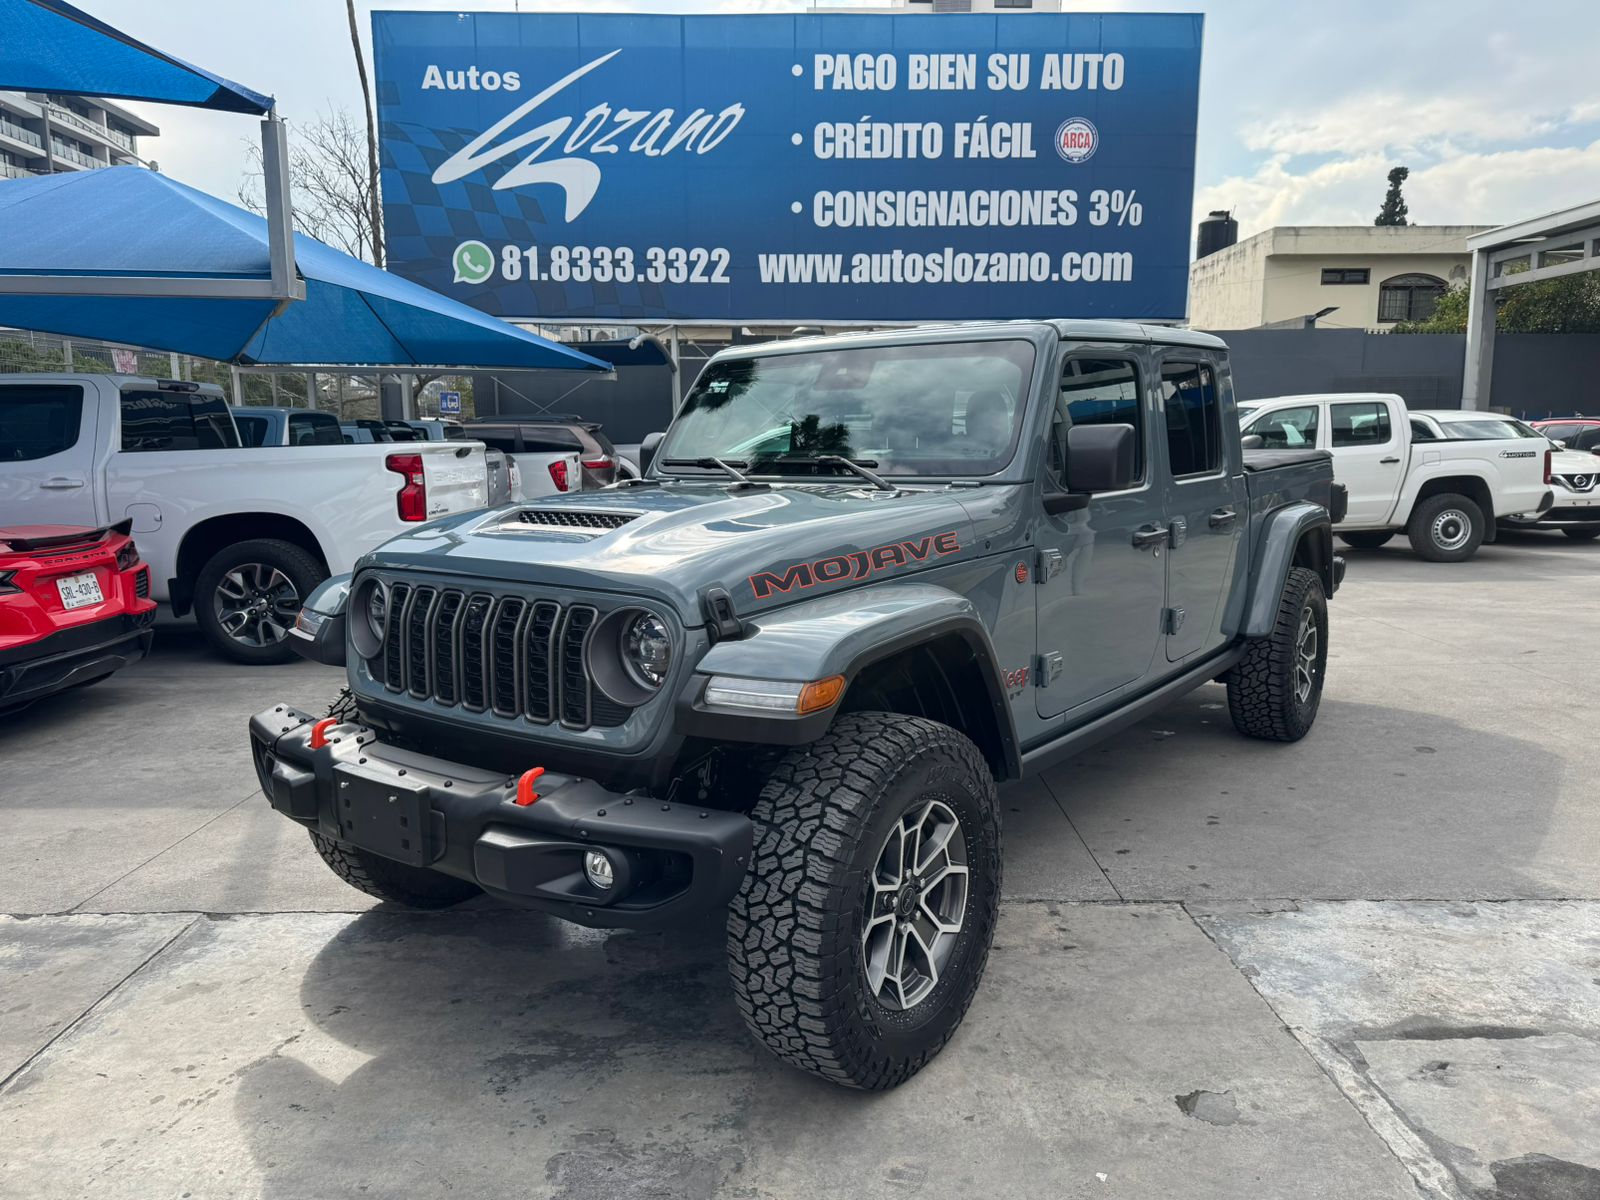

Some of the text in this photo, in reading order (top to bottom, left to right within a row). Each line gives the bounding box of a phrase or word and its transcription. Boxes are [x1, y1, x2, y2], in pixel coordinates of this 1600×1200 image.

[421, 65, 521, 92] Autos
[814, 53, 1125, 91] PAGO BIEN SU AUTO
[431, 49, 746, 224] Lozano
[814, 115, 1037, 159] CRÉDITO FÁCIL
[1062, 132, 1091, 149] ARCA
[813, 189, 1143, 228] CONSIGNACIONES 3%
[501, 245, 731, 284] 81.8333.3322
[758, 247, 1133, 284] www.autoslozano.com
[748, 531, 961, 598] MOJAVE
[61, 581, 100, 600] SRL-430-B
